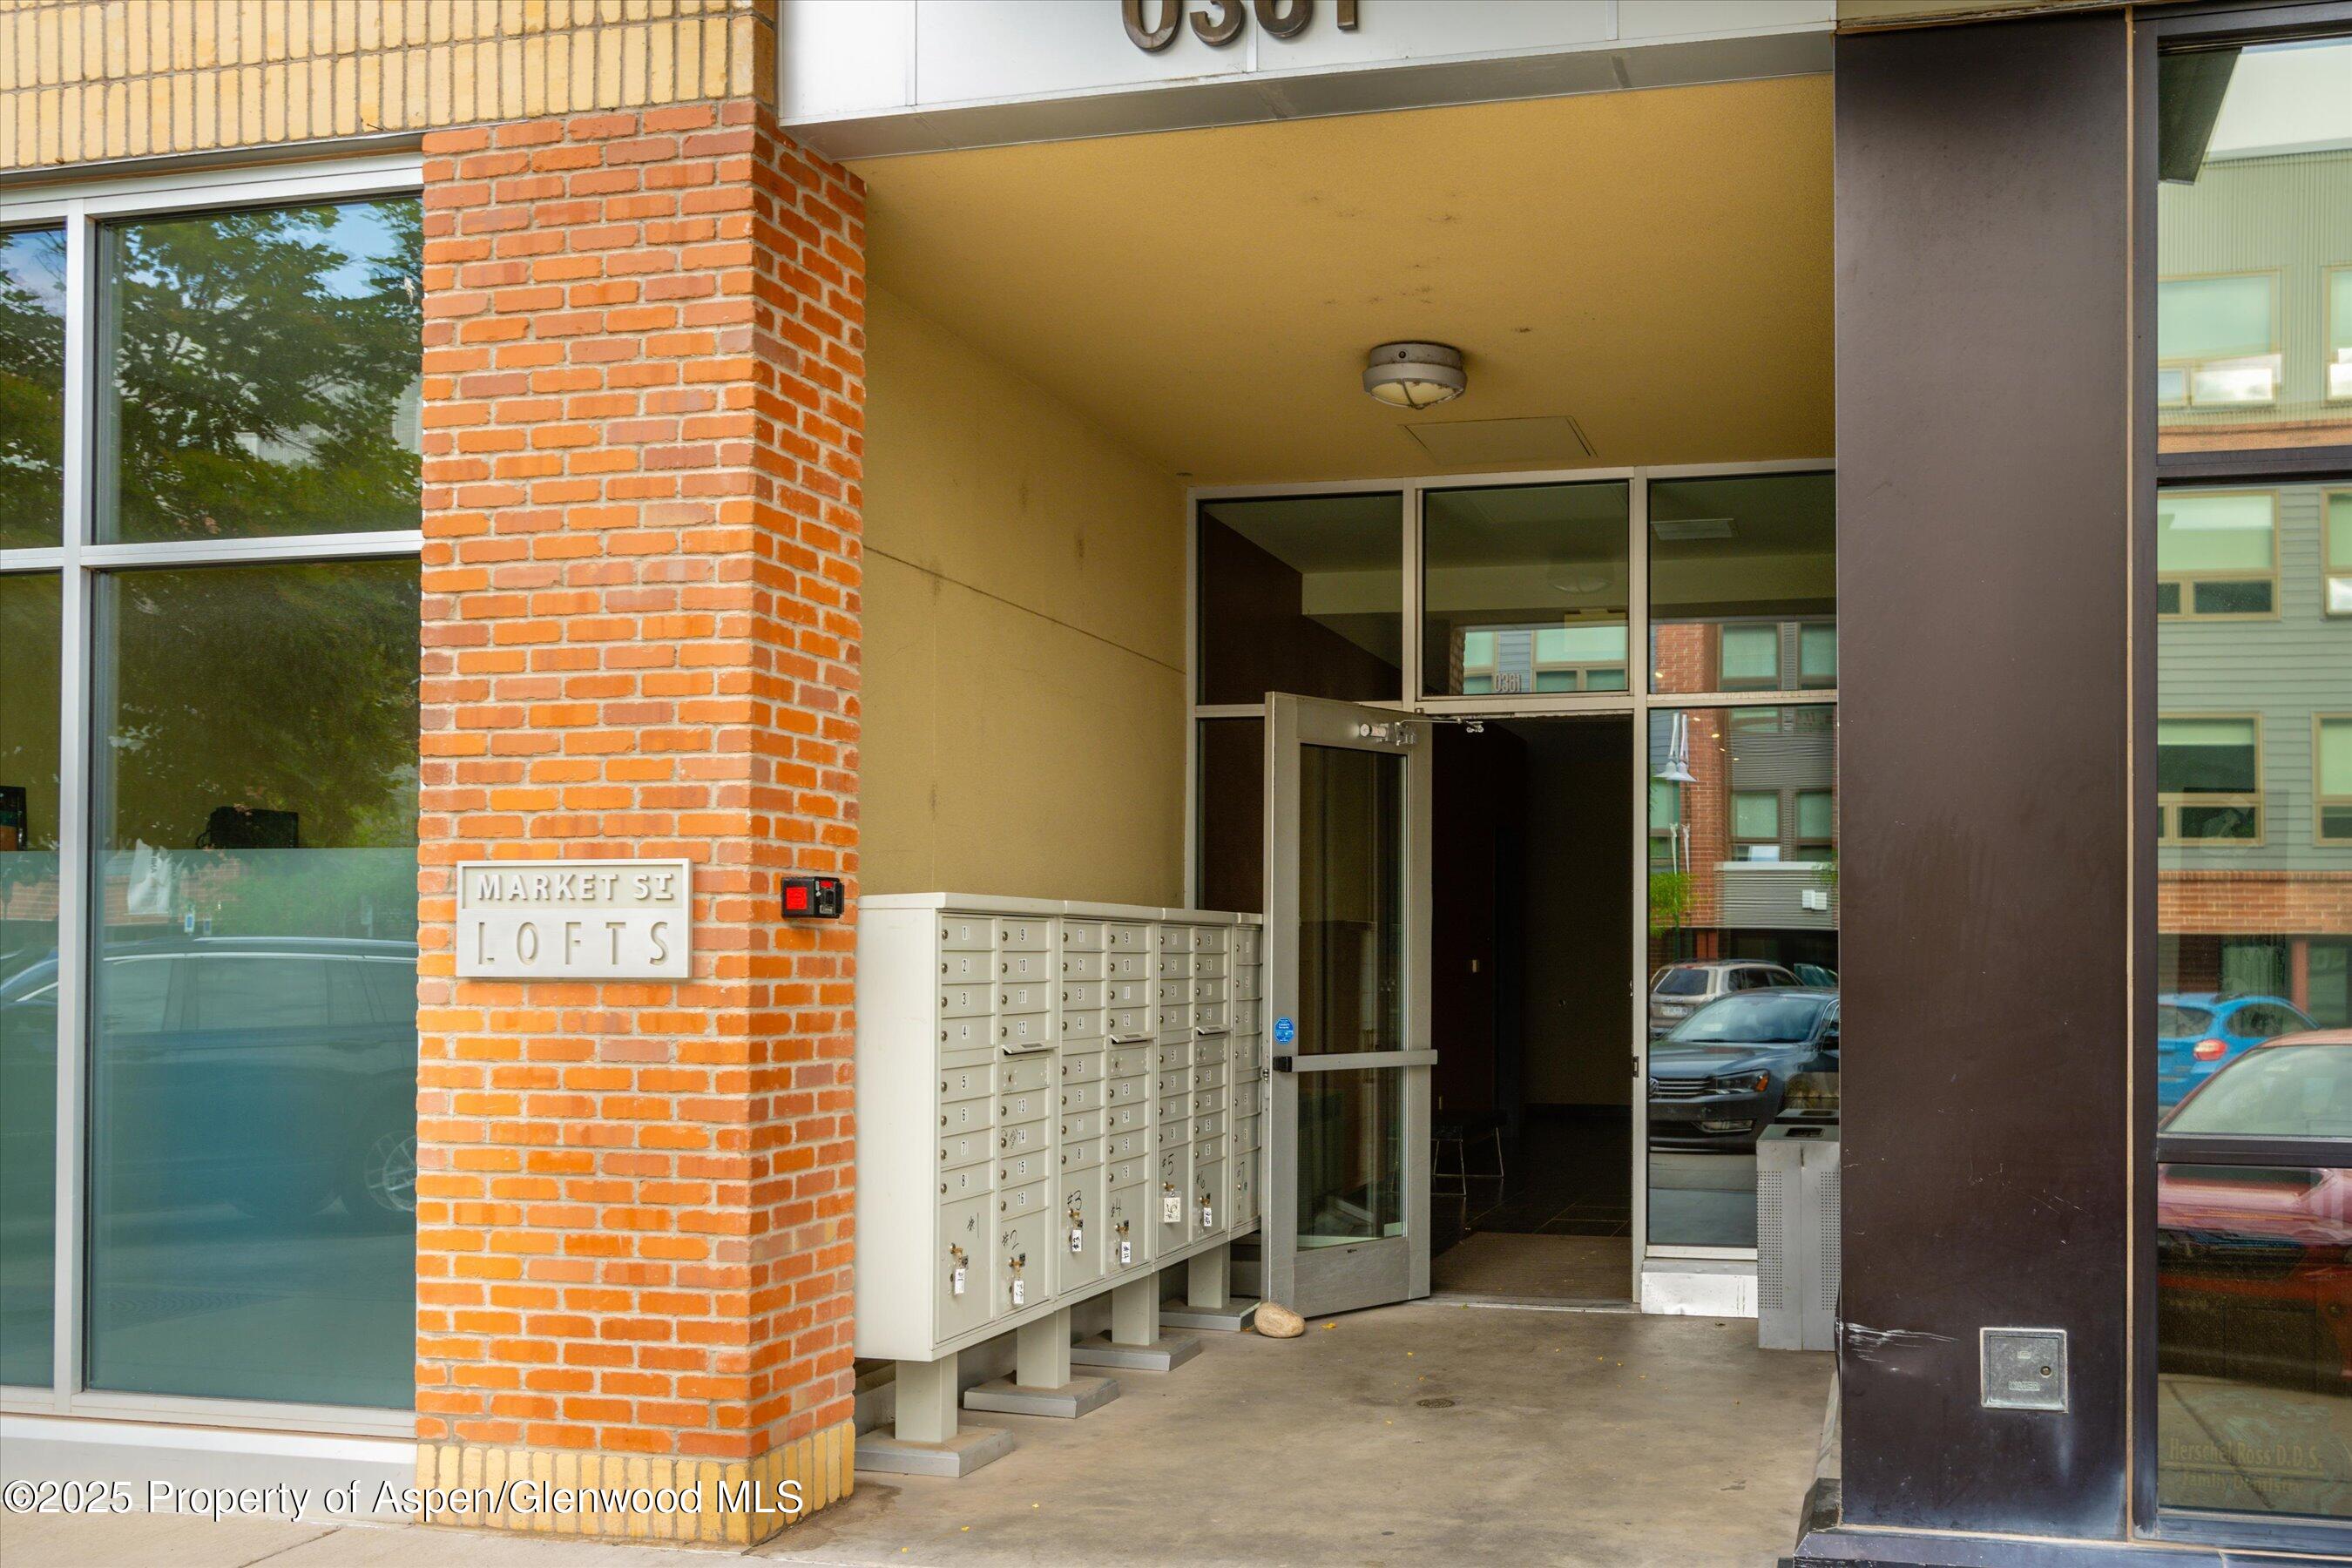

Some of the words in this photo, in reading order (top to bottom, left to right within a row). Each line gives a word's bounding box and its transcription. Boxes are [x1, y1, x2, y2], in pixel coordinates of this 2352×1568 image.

[1494, 673, 1522, 693] 0361
[476, 873, 618, 901] MARKET
[632, 871, 675, 901] ST
[1020, 928, 1025, 941] 9
[477, 921, 669, 966] LOFTS
[1019, 959, 1026, 971] 10
[1019, 990, 1026, 1003] 11
[1018, 1022, 1025, 1034] 12
[1018, 1099, 1025, 1112] 13
[1017, 1130, 1024, 1142] 14
[1017, 1161, 1024, 1173] 15
[1162, 1153, 1174, 1176] #5
[1017, 1192, 1024, 1205] 16
[1067, 1190, 1082, 1210] #3
[1111, 1197, 1122, 1218] #4
[1001, 1229, 1019, 1250] #2
[1072, 1236, 1080, 1250] #3
[2168, 1436, 2233, 1463] Herschel
[2237, 1441, 2272, 1466] Ross
[2276, 1443, 2324, 1470] D.D.S.
[2181, 1471, 2227, 1493] Family
